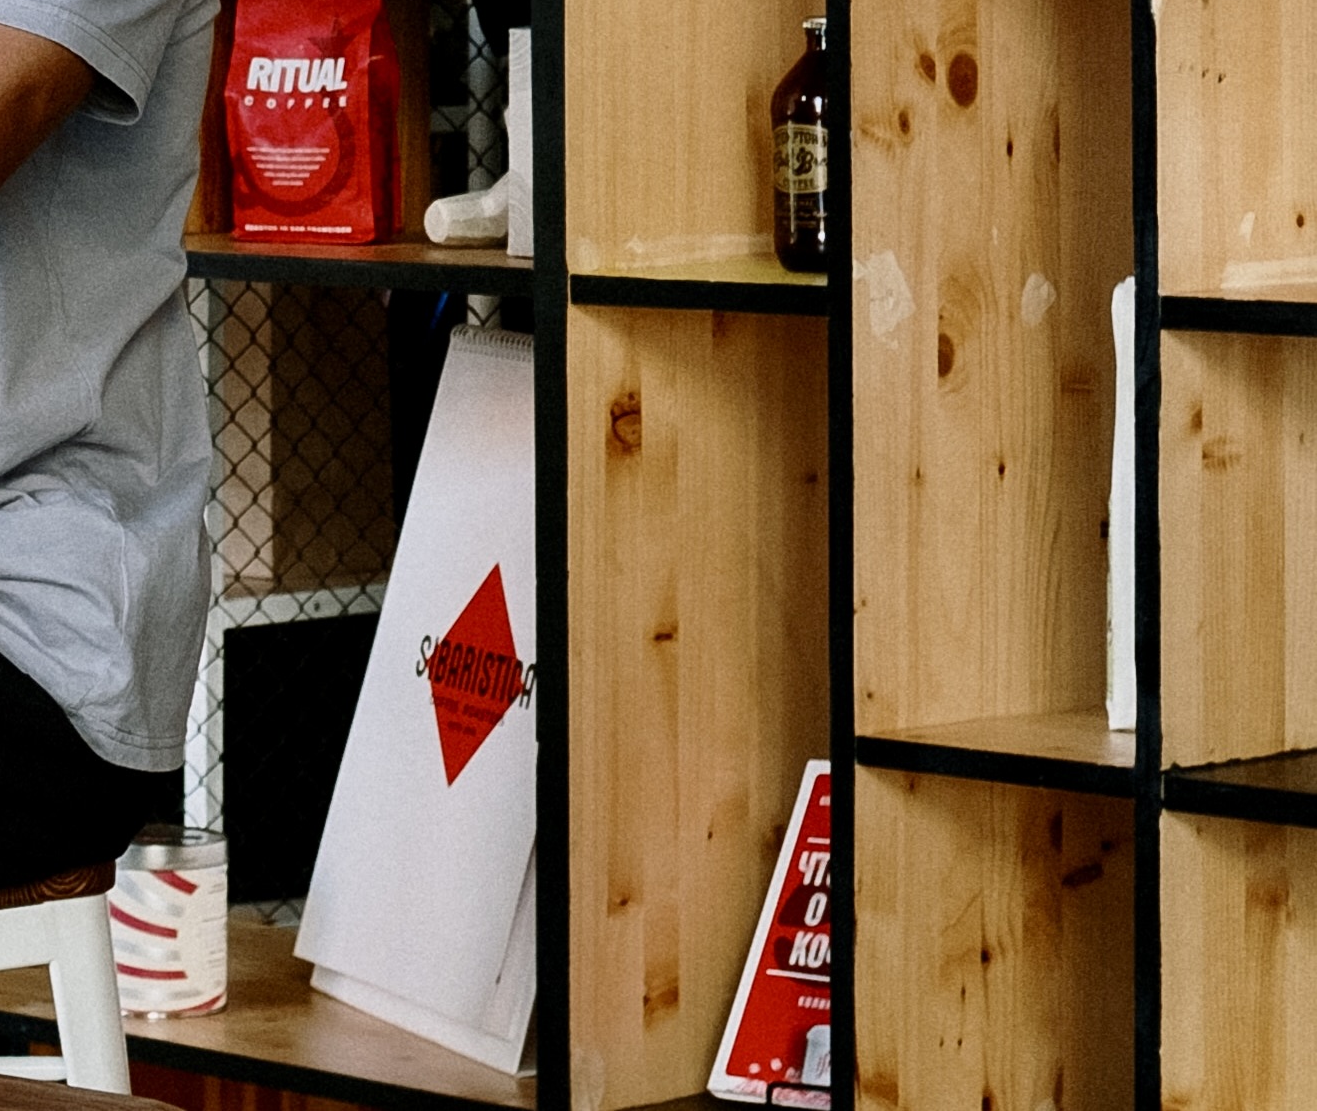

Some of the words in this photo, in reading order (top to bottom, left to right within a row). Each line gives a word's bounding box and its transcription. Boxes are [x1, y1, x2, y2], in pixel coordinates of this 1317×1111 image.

[247, 57, 348, 94] RITUAL
[244, 95, 348, 110] COFFEE
[416, 634, 537, 710] SIBARISTICA
[798, 850, 831, 887] ЧТ
[788, 930, 831, 969] КО
